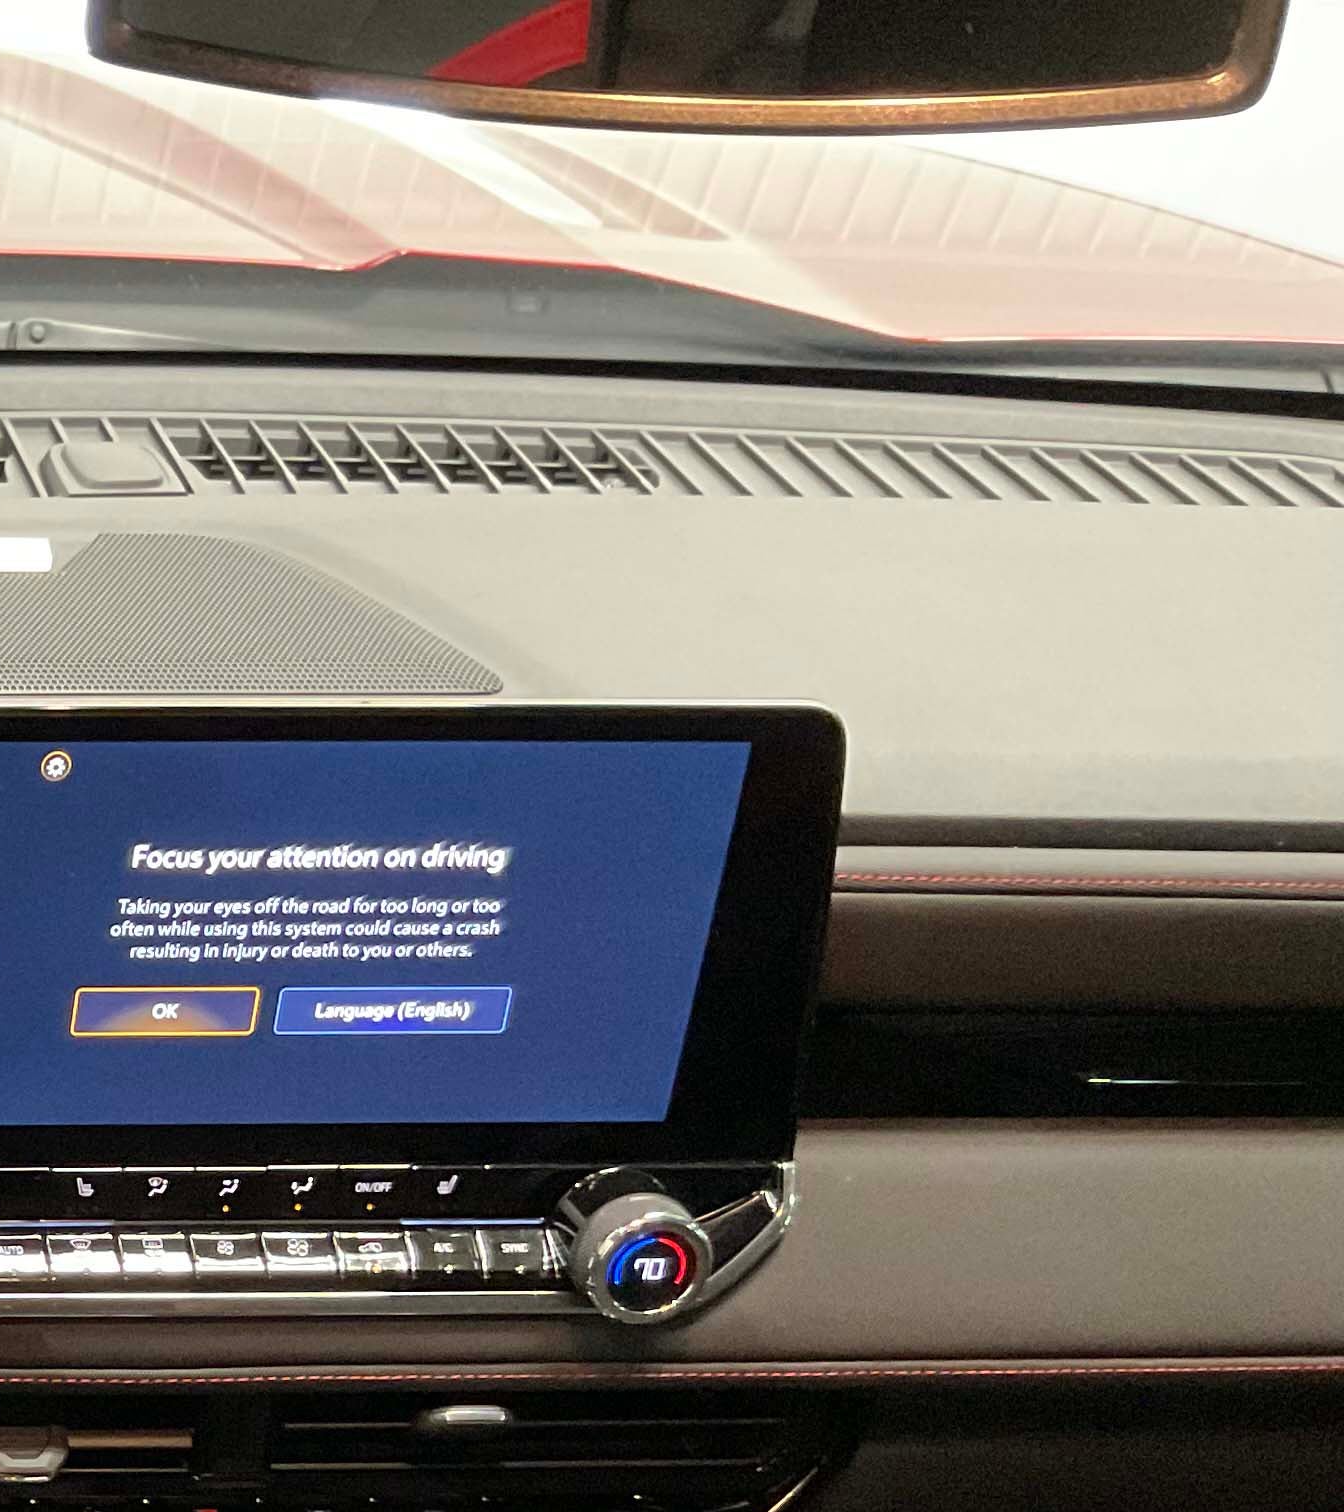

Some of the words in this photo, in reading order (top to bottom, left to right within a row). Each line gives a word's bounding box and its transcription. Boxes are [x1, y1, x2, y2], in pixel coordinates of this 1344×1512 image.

[131, 844, 204, 869] Focus
[205, 848, 266, 875] your
[266, 844, 378, 869] attention
[384, 848, 416, 868] on
[421, 842, 507, 874] driving
[118, 898, 171, 918] Taking
[172, 902, 211, 918] your
[214, 902, 250, 918] eyes
[254, 897, 281, 914] off
[282, 899, 309, 914] the
[312, 898, 350, 914] road
[353, 896, 378, 914] for
[380, 900, 408, 914] too
[412, 898, 448, 917] long
[451, 902, 470, 914] or
[473, 899, 501, 913] too
[110, 921, 154, 937] often
[158, 921, 201, 937] while
[204, 921, 248, 940] using
[252, 920, 282, 936] this
[284, 922, 341, 939] system
[345, 920, 391, 936] could
[393, 924, 439, 936] cause
[442, 924, 453, 936] a
[455, 919, 500, 935] crash
[129, 943, 200, 962] resulting
[204, 943, 218, 958] in
[223, 943, 269, 962] injury
[271, 946, 291, 958] or
[291, 942, 339, 958] death
[342, 944, 359, 958] to
[361, 946, 392, 961] you
[395, 946, 413, 958] or
[415, 942, 473, 958] others.
[151, 1003, 179, 1019] OK
[314, 1002, 394, 1021] Language
[397, 1002, 470, 1021] (English)
[355, 1182, 392, 1193] ON/OFF
[501, 1243, 529, 1253] SYNC
[634, 1258, 667, 1281] 70
